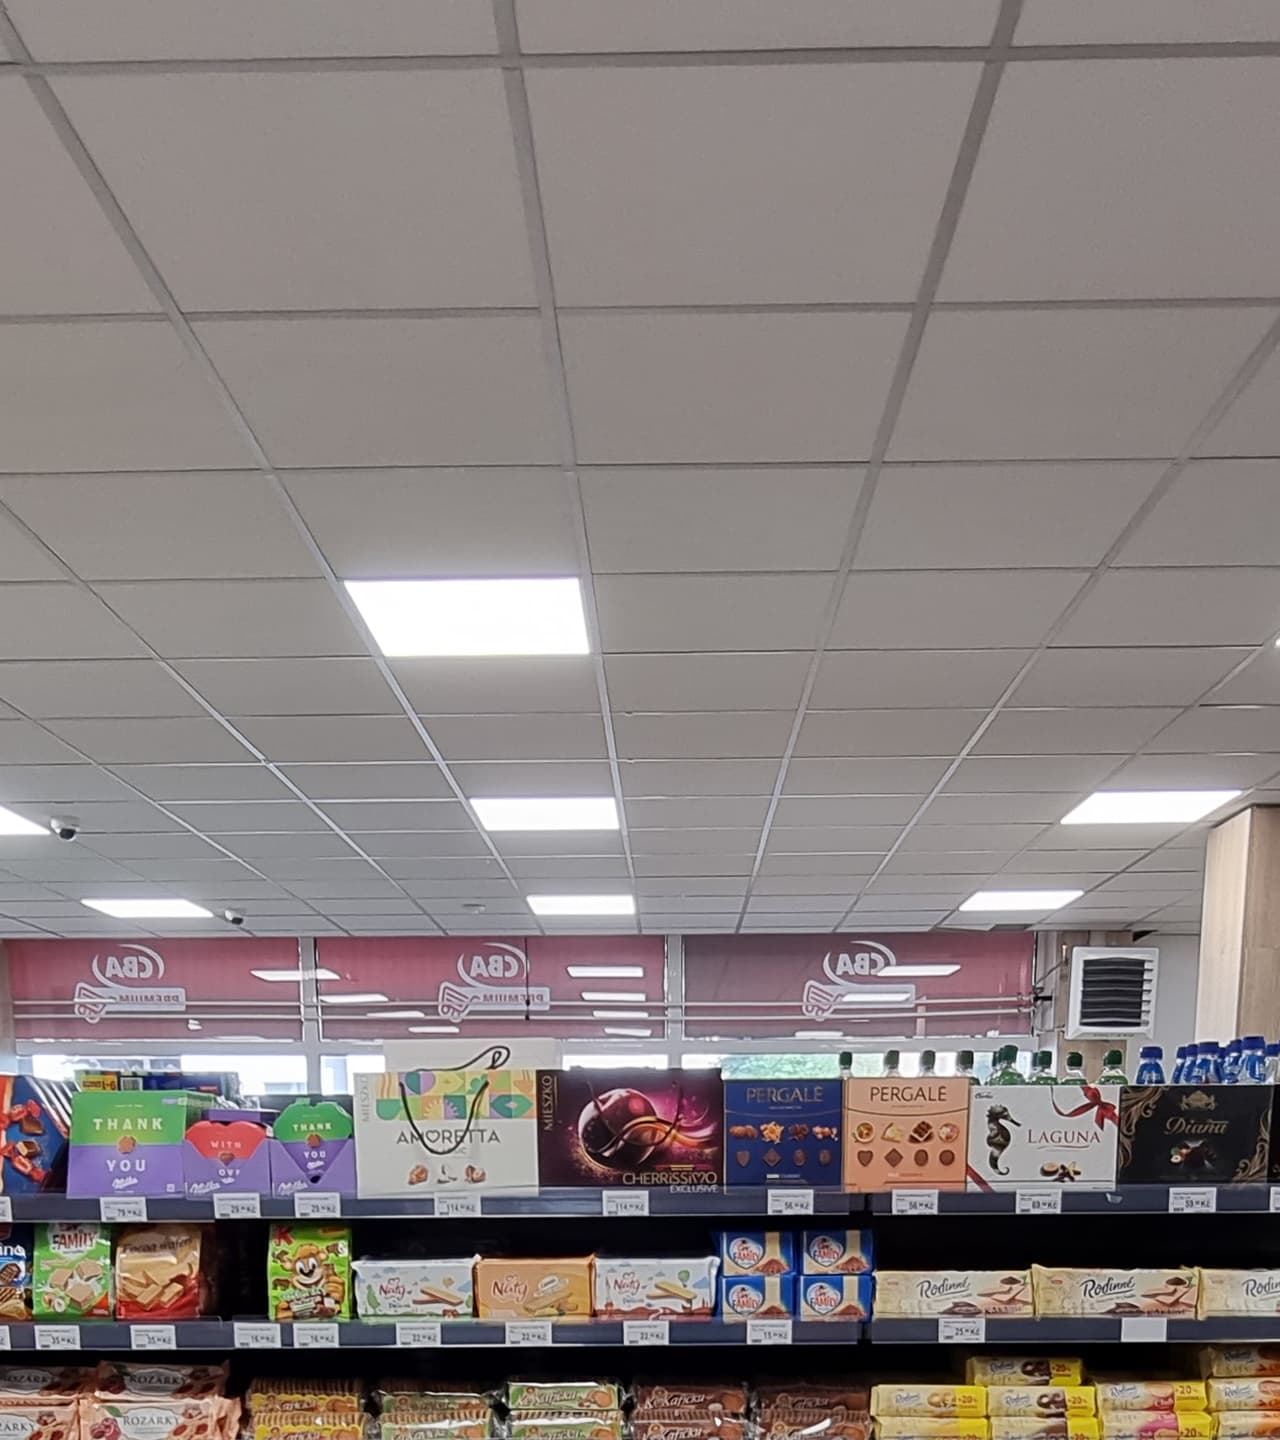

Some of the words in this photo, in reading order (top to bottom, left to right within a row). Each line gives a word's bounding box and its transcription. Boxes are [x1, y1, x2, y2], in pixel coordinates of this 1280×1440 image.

[542, 1075, 552, 1130] MIESZKO
[93, 1117, 163, 1131] THANK
[292, 1122, 332, 1133] THANK
[1164, 1117, 1229, 1137] Diana
[210, 1139, 241, 1150] WITH
[396, 1129, 501, 1145] AMORETTA
[1027, 1128, 1101, 1145] LAGUNA
[303, 1151, 326, 1160] YOU
[106, 1158, 146, 1173] YOU
[670, 1185, 718, 1193] EXCLUSIVE
[492, 1280, 528, 1301] Naty
[917, 1279, 971, 1299] Rodinné
[1081, 1279, 1136, 1297] Rodinné
